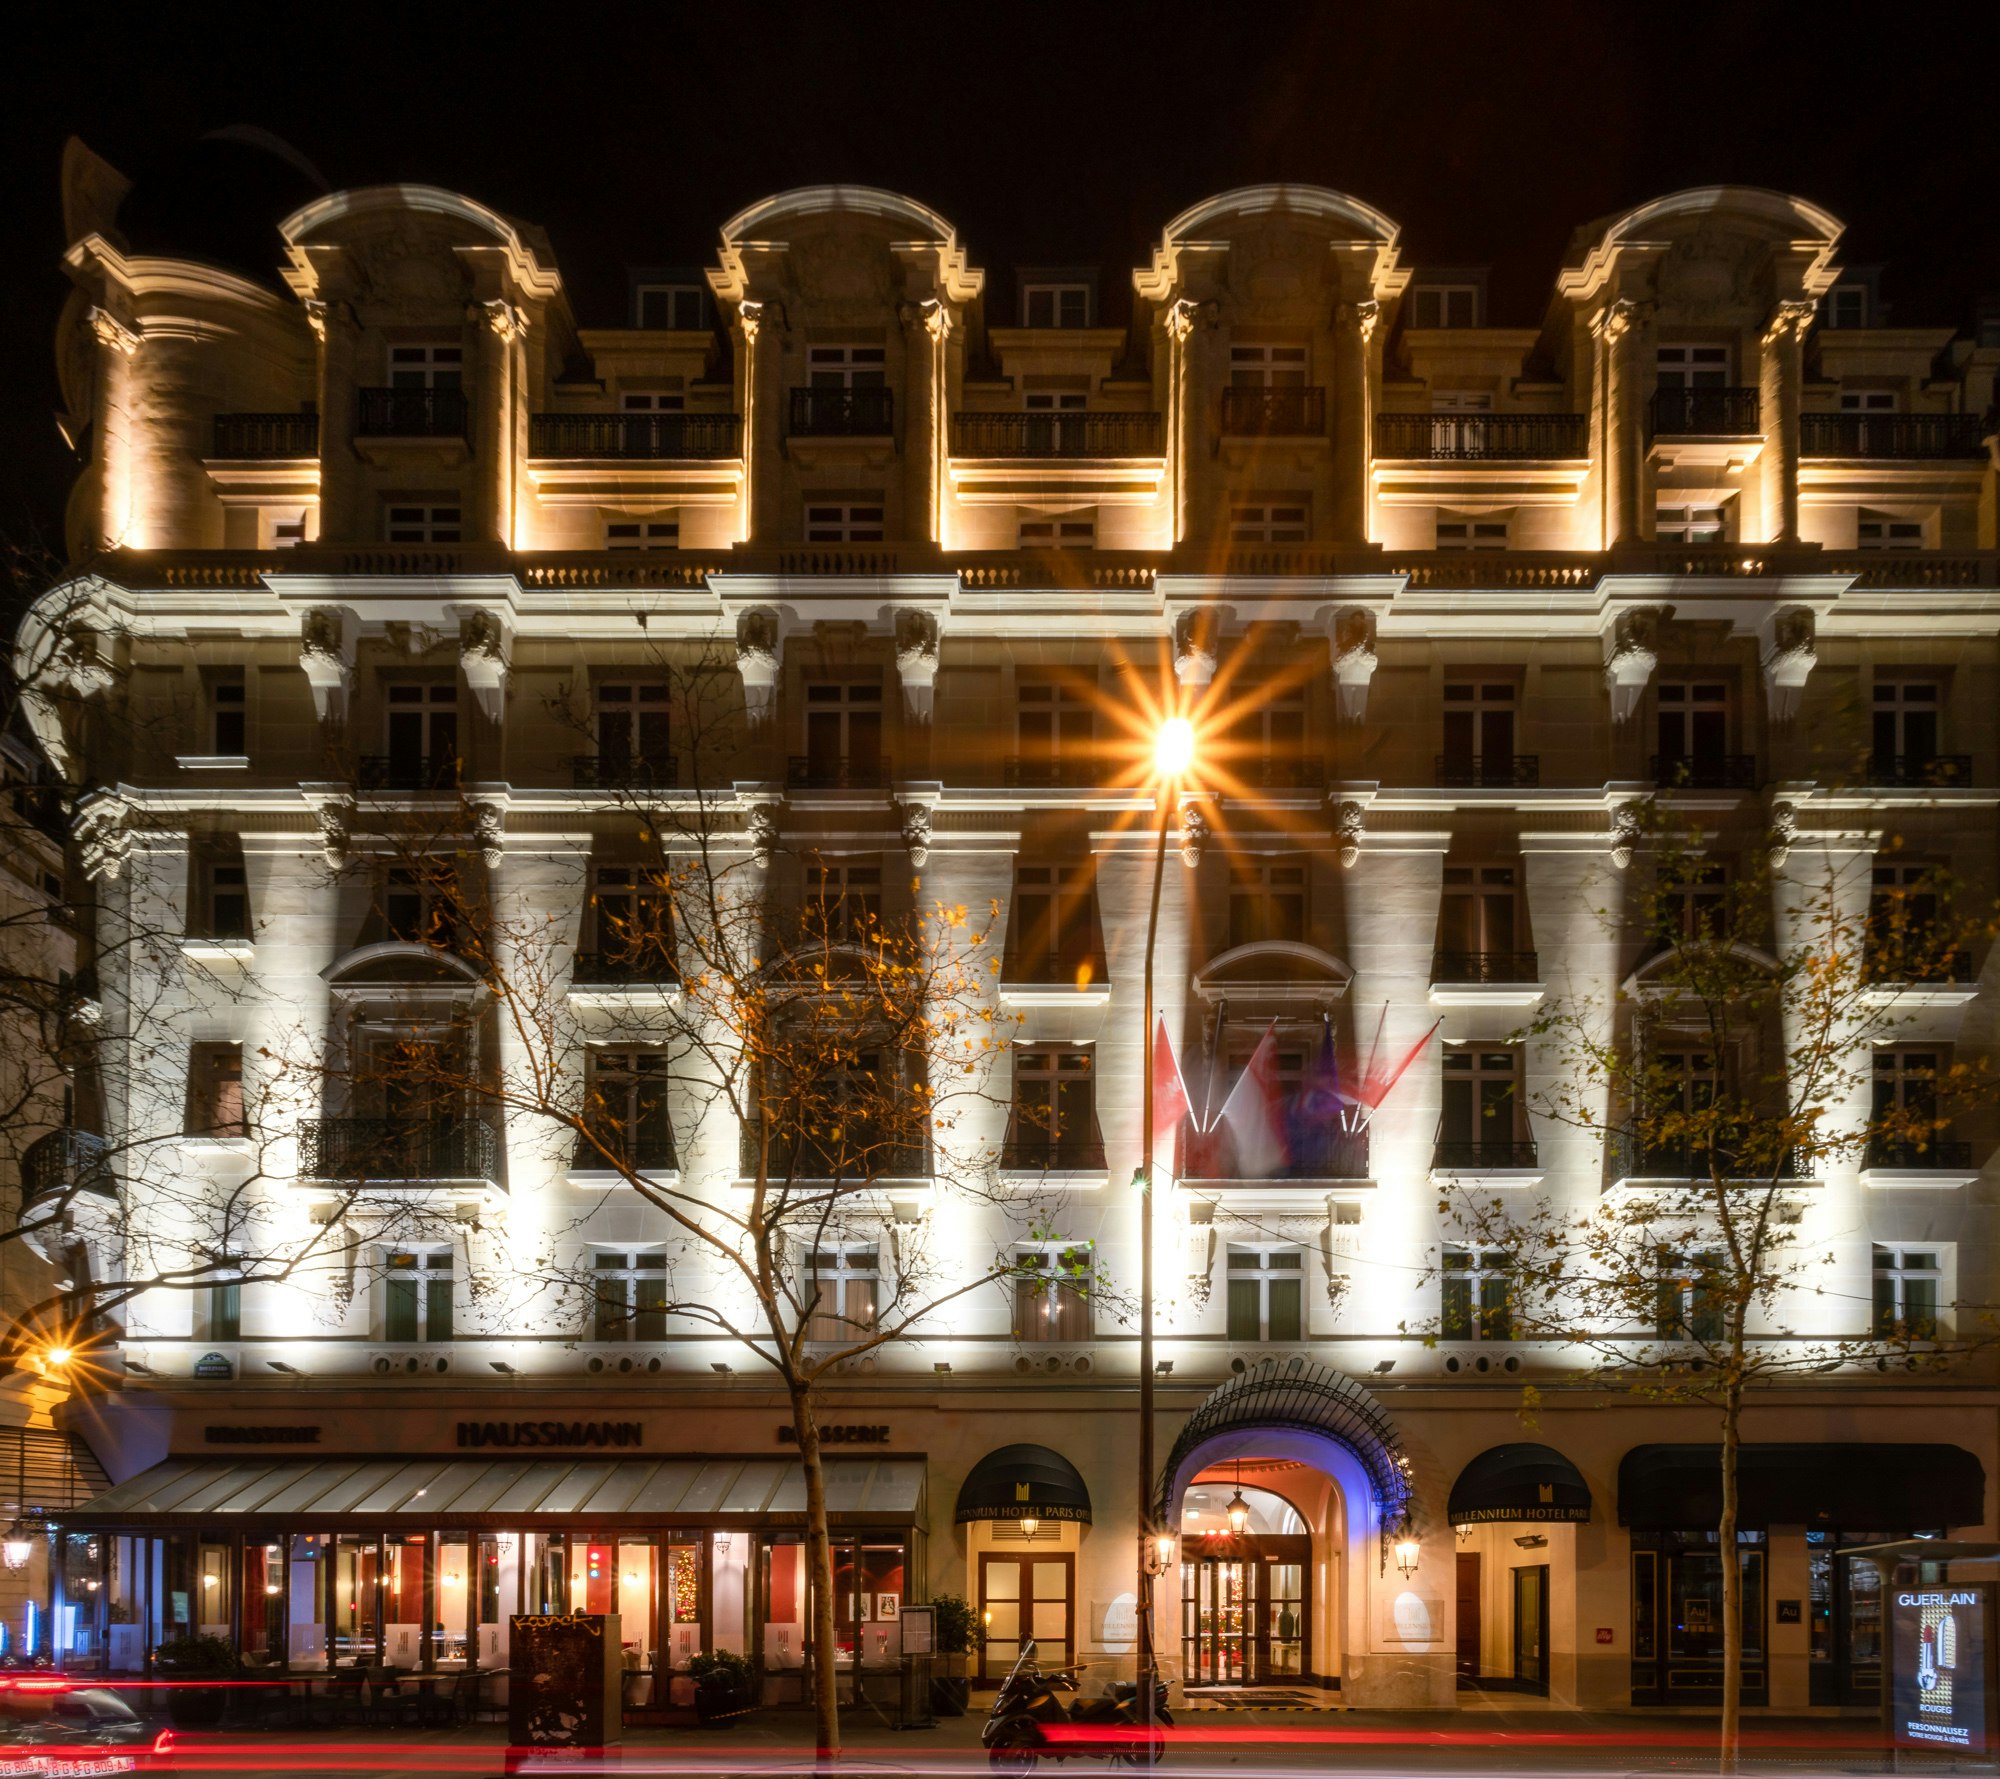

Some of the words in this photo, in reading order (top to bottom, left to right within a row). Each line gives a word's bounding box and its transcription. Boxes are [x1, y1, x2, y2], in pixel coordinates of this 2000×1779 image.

[456, 1422, 642, 1447] HAUSSMANN
[778, 1425, 890, 1443] BSSERIE
[1001, 1506, 1042, 1518] HOTEL
[1046, 1506, 1074, 1519] PARIS
[1526, 1508, 1566, 1519] HOTEL
[1898, 1592, 1976, 1606] GUERLAIN
[1781, 1607, 1798, 1617] Au
[1907, 1721, 1969, 1737] PERSONNALISEZ
